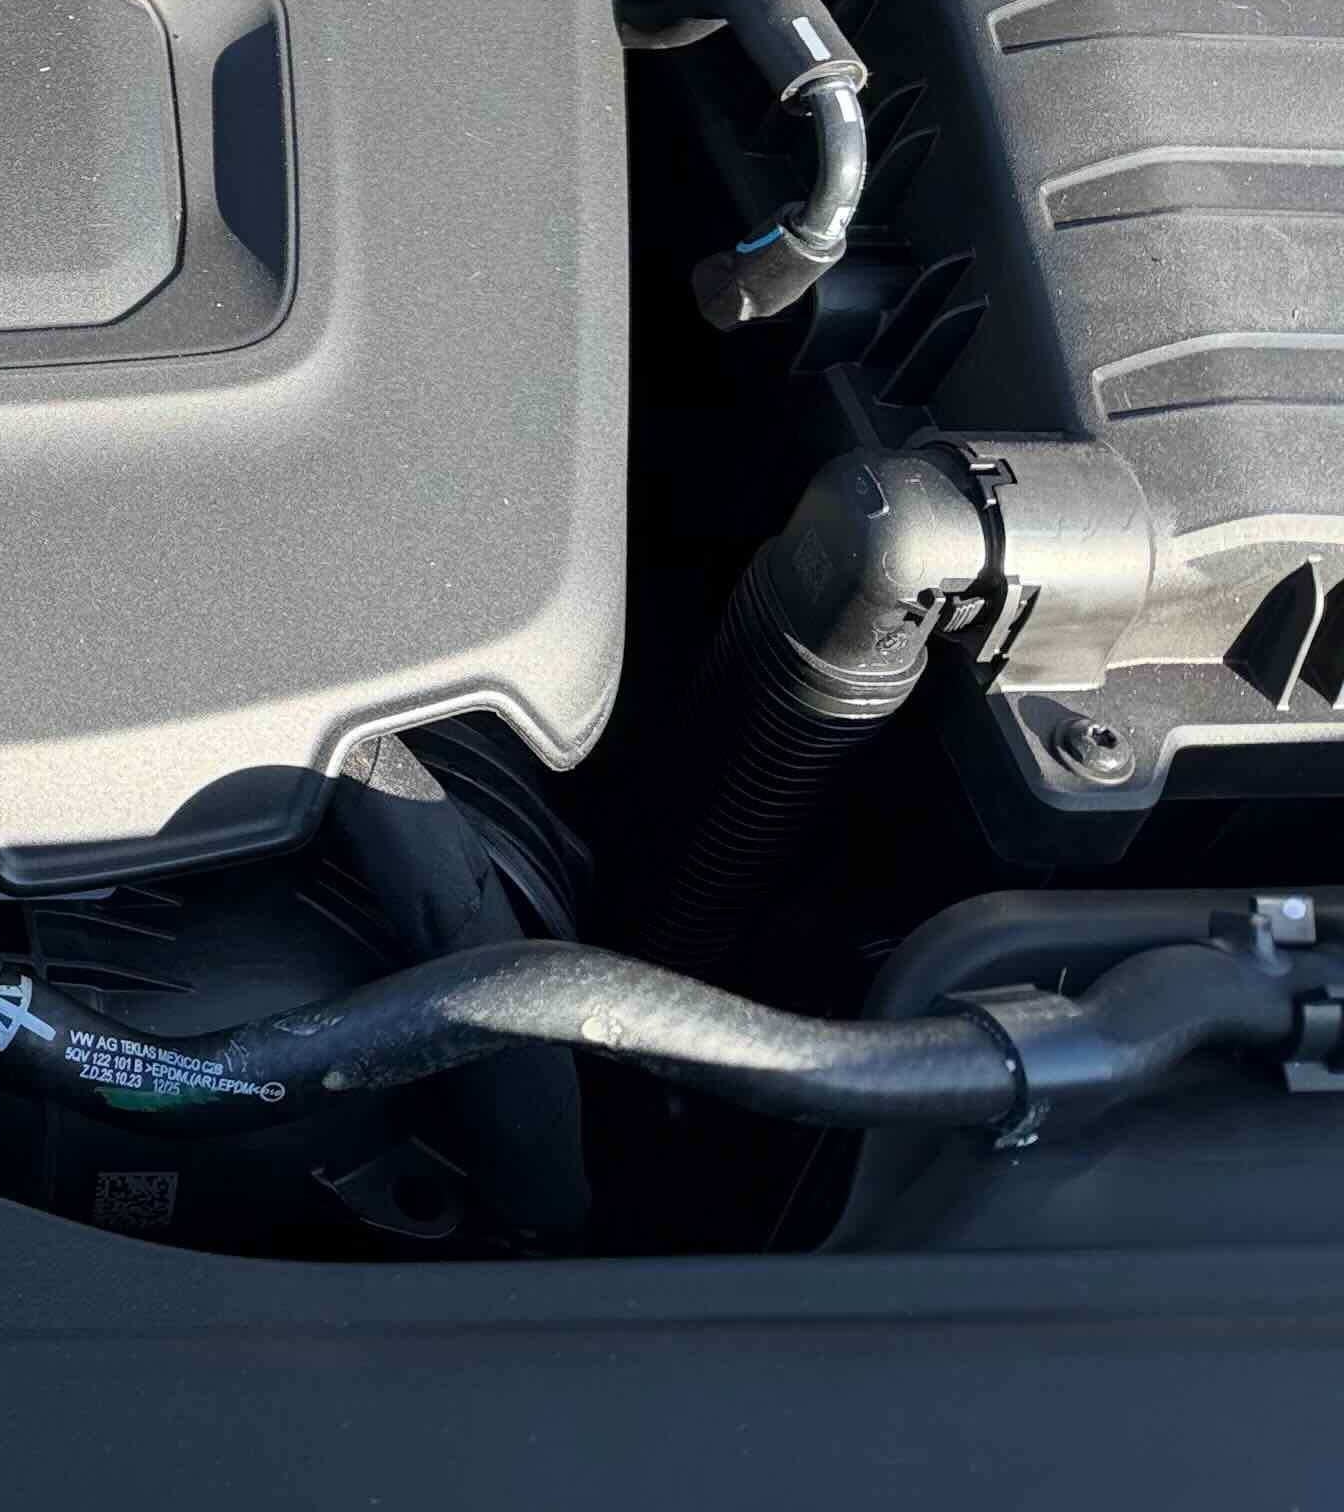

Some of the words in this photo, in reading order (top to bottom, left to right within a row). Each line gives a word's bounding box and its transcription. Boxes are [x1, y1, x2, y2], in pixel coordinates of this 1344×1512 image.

[69, 1030, 95, 1048] VW
[95, 1036, 119, 1052] AG
[120, 1039, 157, 1060] TEKLAS
[157, 1048, 201, 1071] MEXICO
[92, 1051, 113, 1068] 122
[113, 1055, 132, 1072] 101
[133, 1058, 144, 1073] B
